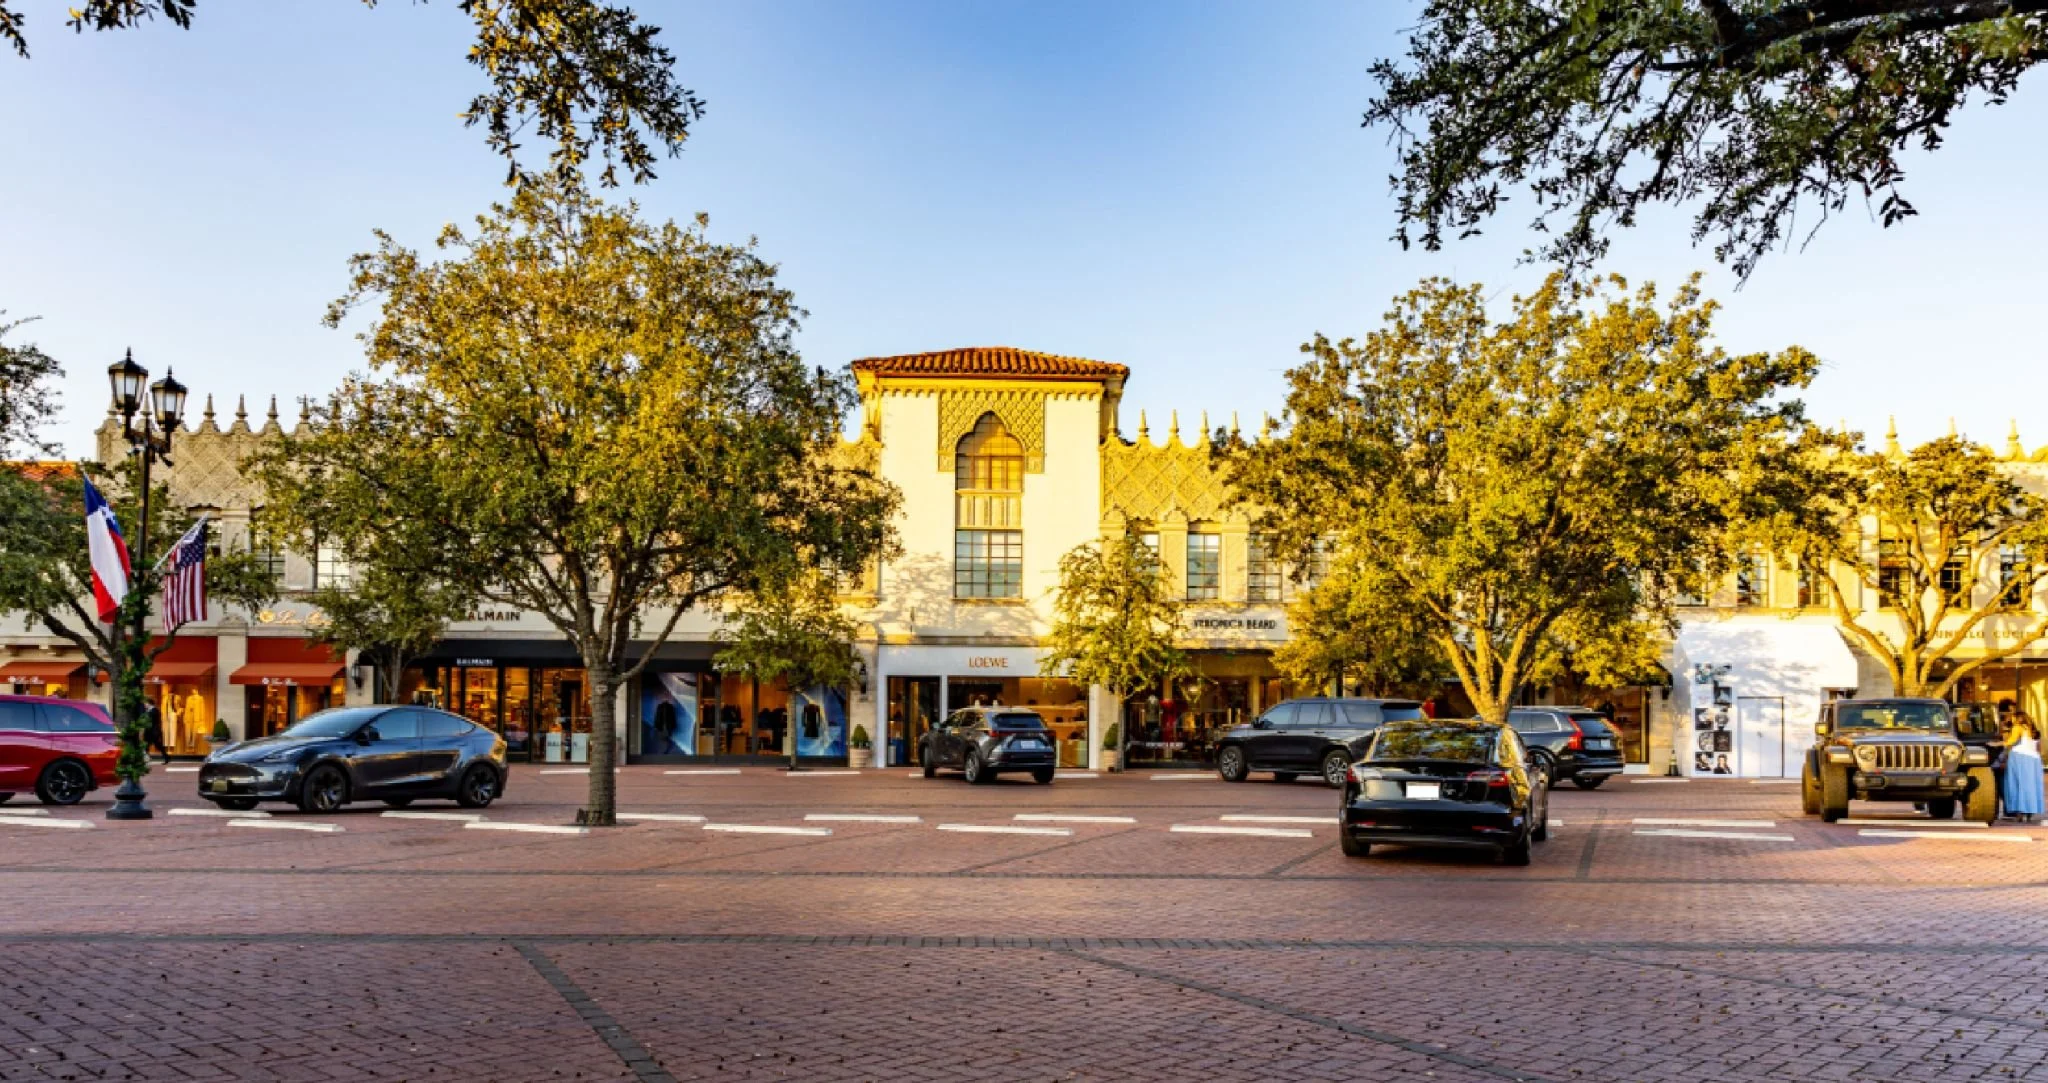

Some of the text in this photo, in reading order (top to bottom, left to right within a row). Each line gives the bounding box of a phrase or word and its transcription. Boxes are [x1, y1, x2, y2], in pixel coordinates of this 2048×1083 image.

[463, 611, 521, 621] ALMAIN
[1246, 619, 1276, 629] BEARD
[968, 656, 1009, 668] LOEWE
